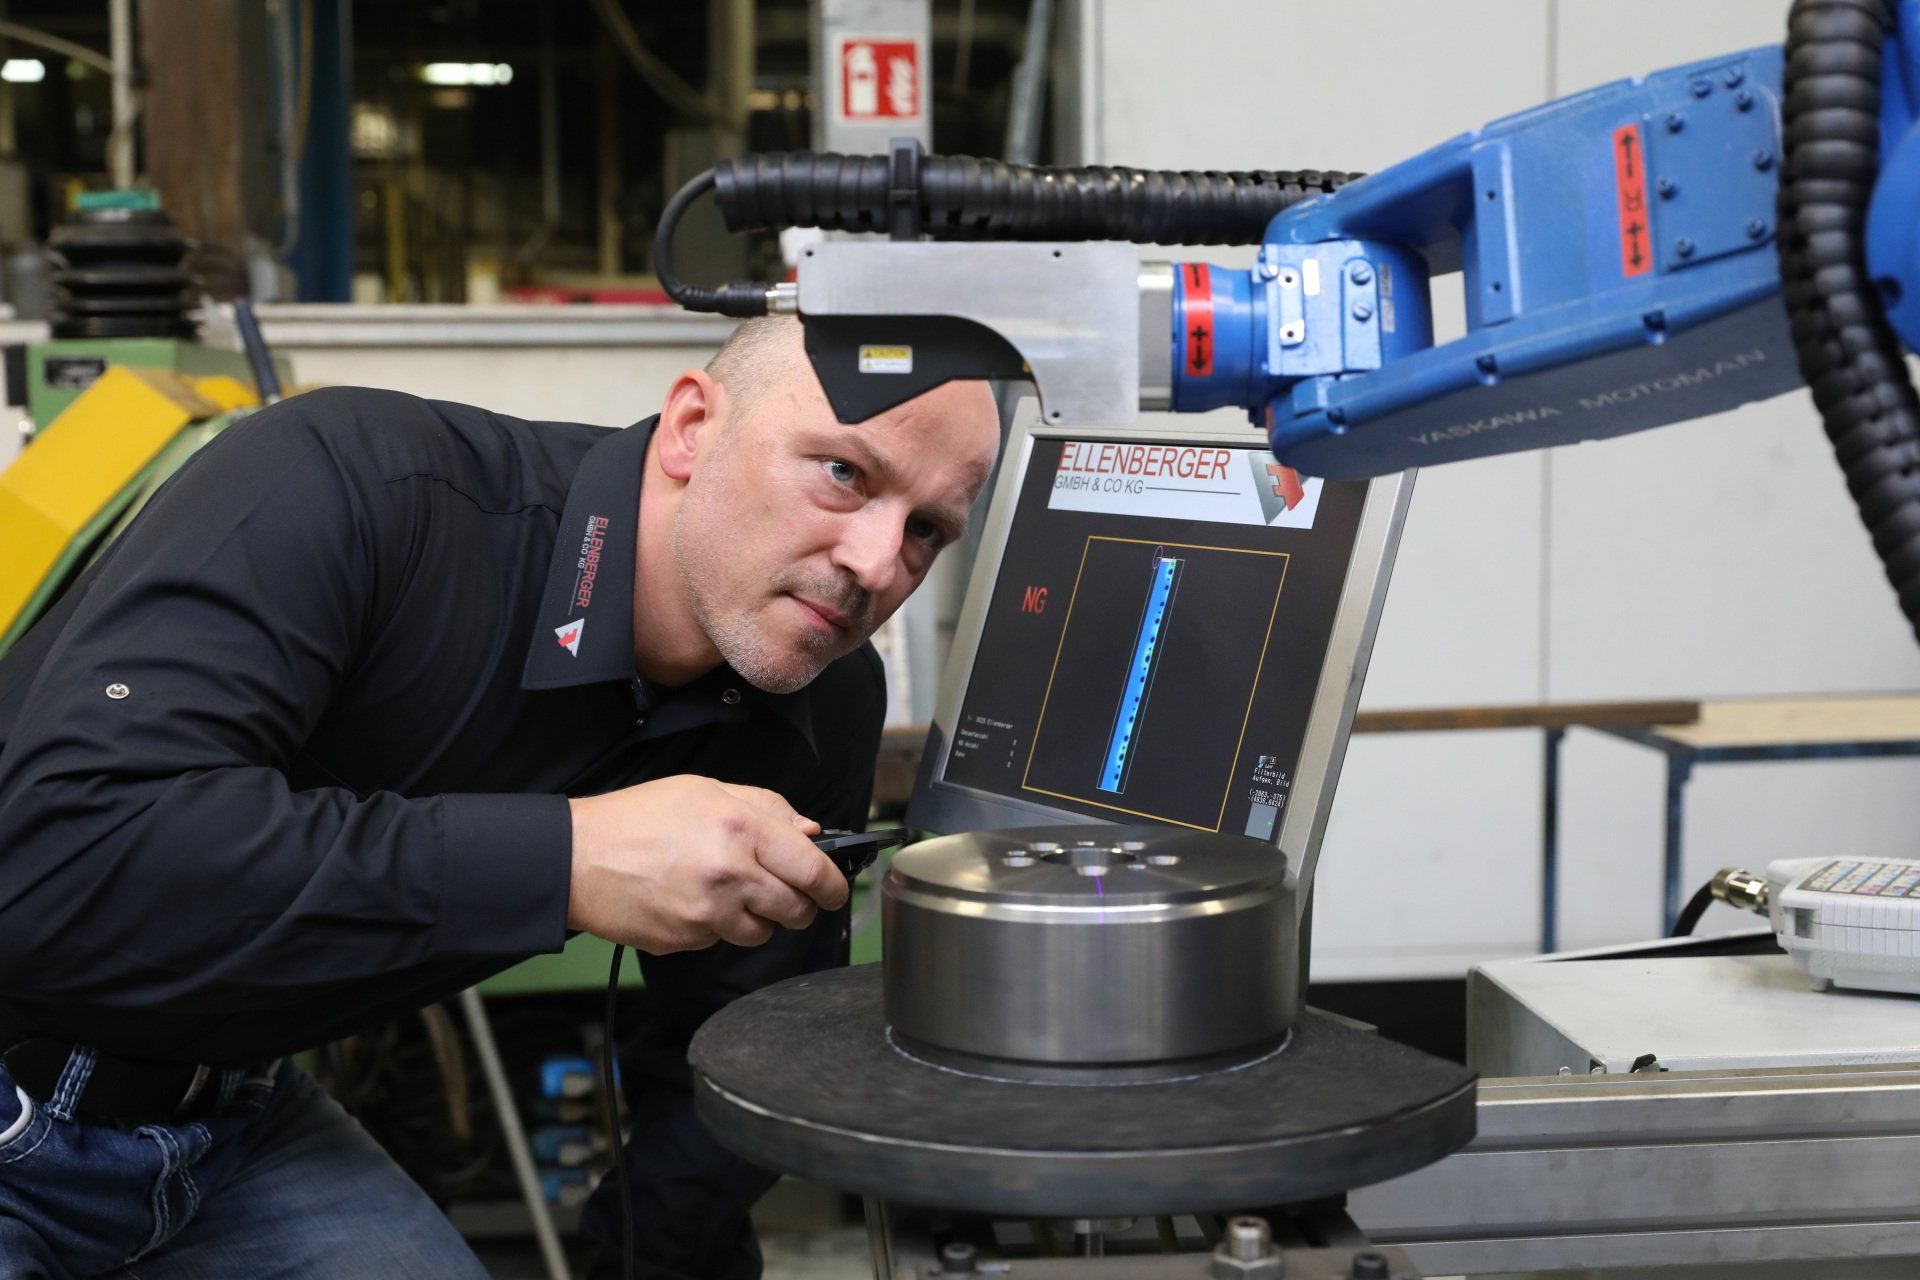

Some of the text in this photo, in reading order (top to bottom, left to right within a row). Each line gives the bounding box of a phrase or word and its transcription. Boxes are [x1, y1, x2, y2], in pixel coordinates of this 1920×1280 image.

[1408, 349, 1766, 446] YASKAWA MOTOMAN
[1057, 443, 1231, 480] ELLENBERGER
[1054, 474, 1144, 494] GMBH & CO KG
[586, 515, 596, 537] GMBH
[580, 543, 590, 555] CO
[575, 516, 609, 608] ELLENBERGER
[577, 557, 586, 569] KG
[1021, 585, 1048, 614] NG
[1254, 767, 1285, 779] Filterbild
